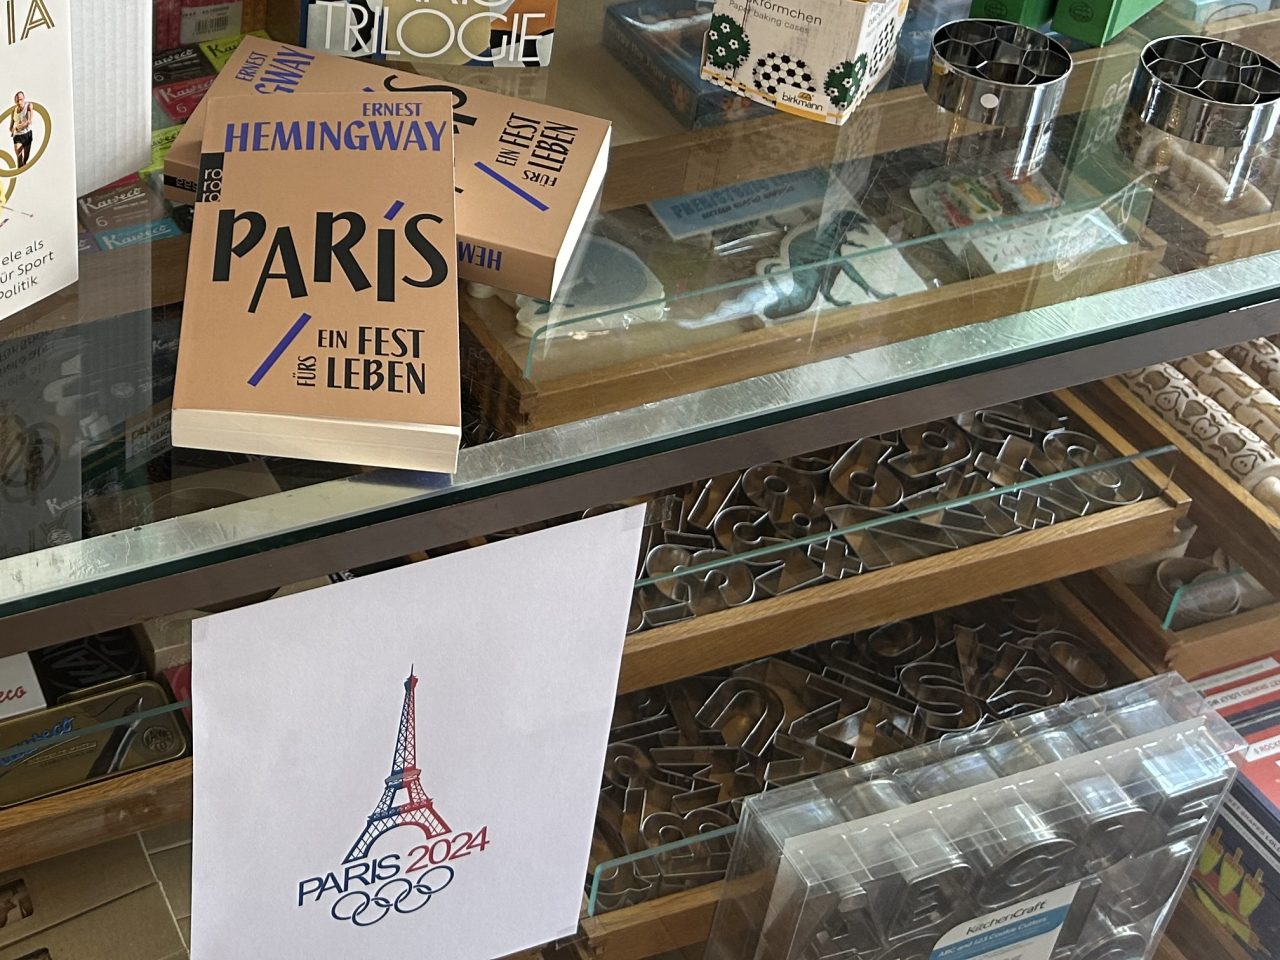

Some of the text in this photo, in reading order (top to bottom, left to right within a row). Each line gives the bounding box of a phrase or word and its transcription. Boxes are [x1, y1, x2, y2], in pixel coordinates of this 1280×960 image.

[314, 0, 547, 63] TRILOGIE
[235, 50, 270, 83] ERNEST
[362, 101, 423, 118] ERNEST
[781, 91, 824, 112] birkmann
[223, 119, 447, 153] HEMINGWAY
[494, 111, 543, 167] EIN FEST
[520, 120, 580, 188] FÜRS LEBEN
[16, 250, 55, 278] Sport
[24, 239, 45, 256] als
[317, 326, 425, 359] EIN FEST
[291, 354, 426, 394] FÜRS LEBEN
[296, 824, 491, 907] PARIS 2024
